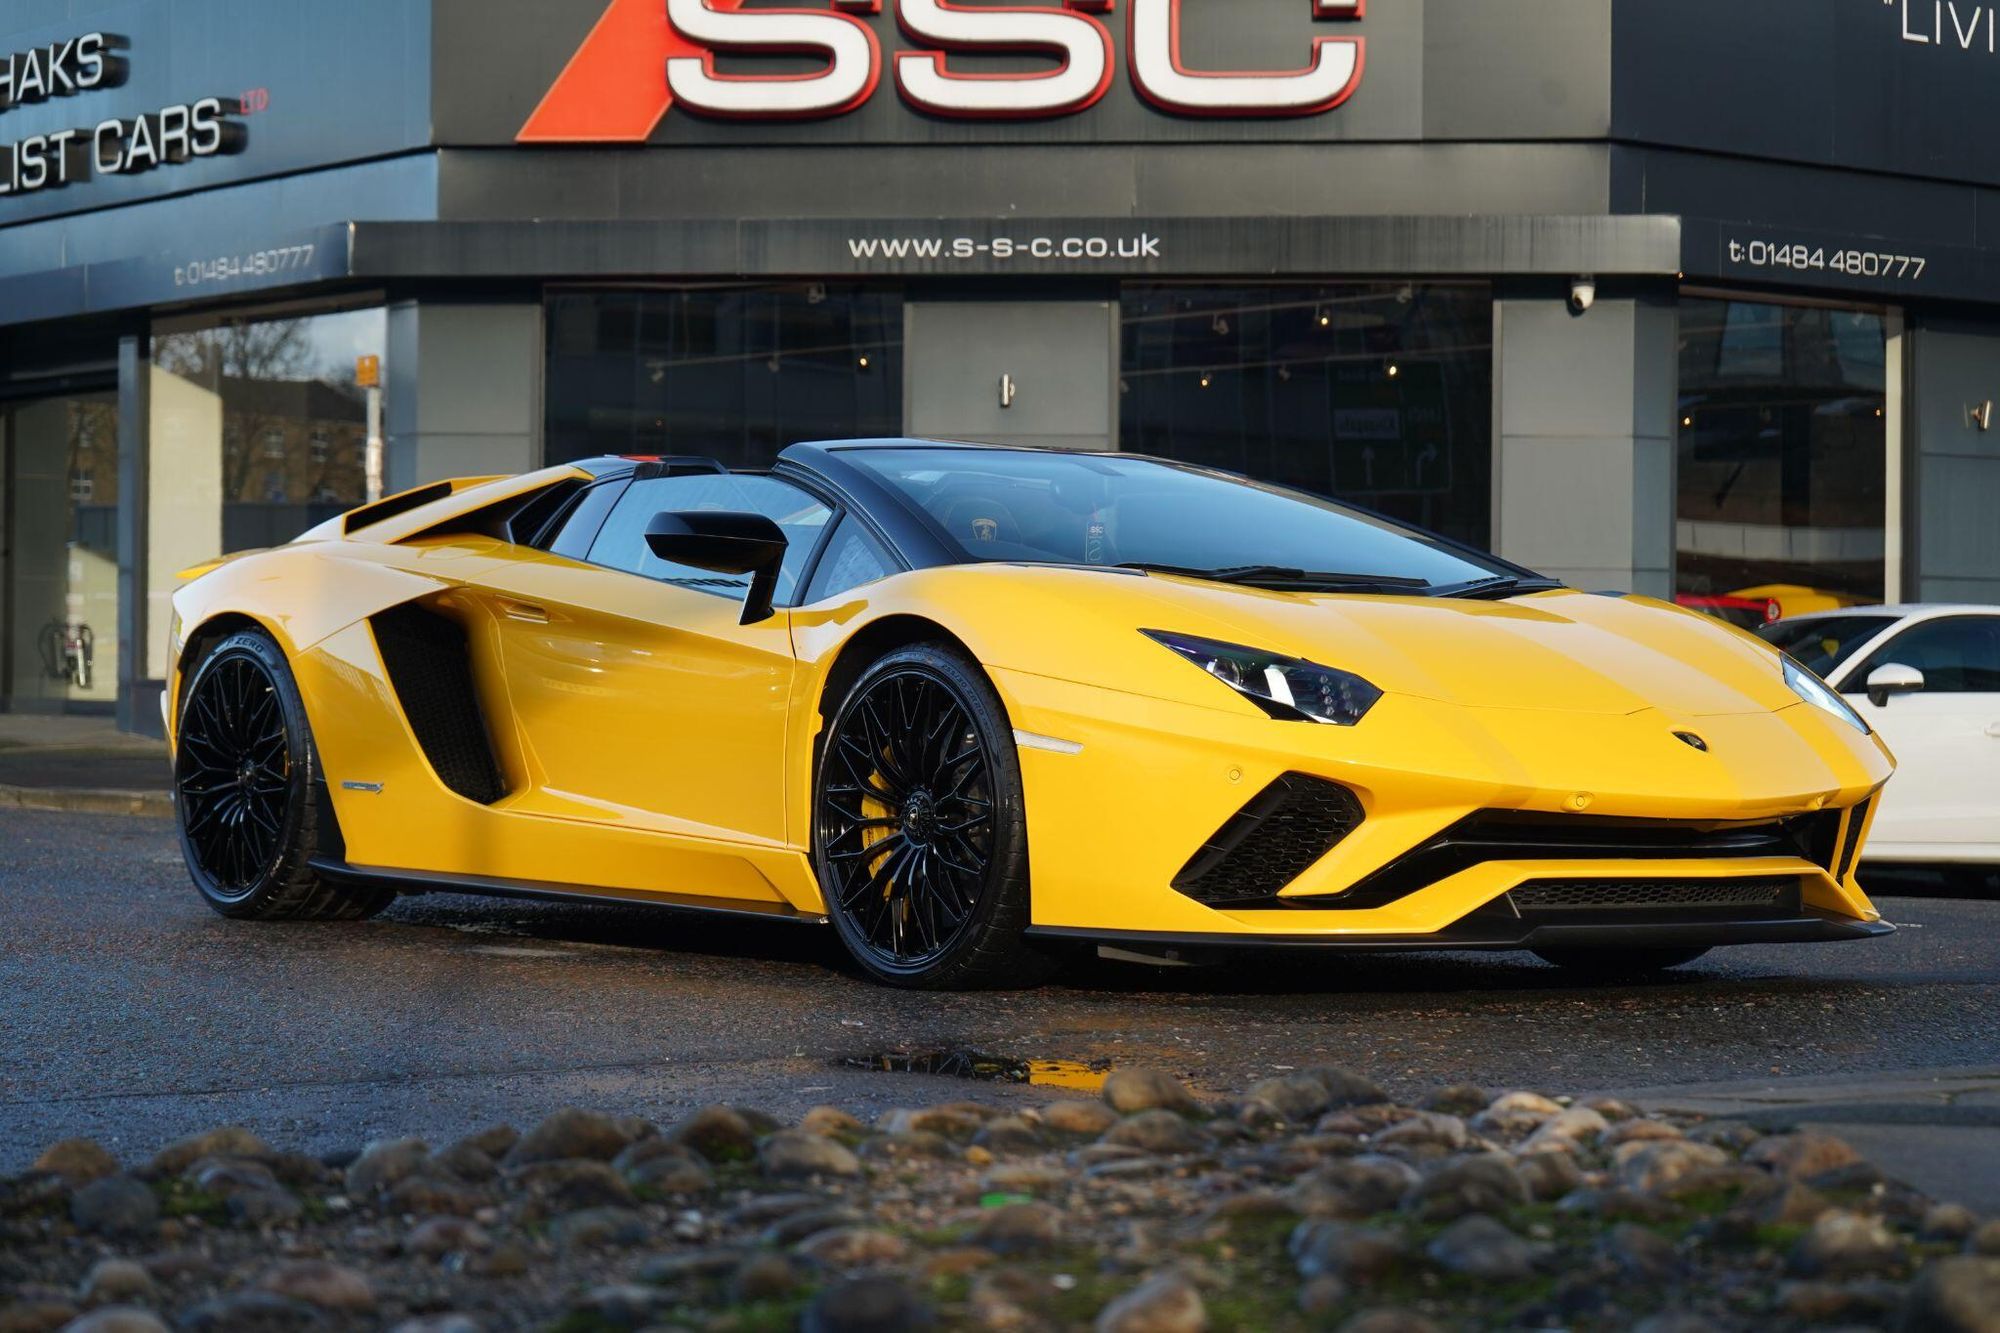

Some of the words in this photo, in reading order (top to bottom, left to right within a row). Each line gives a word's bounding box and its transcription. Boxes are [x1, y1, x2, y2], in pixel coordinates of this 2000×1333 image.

[667, 0, 1365, 118] SSC
[94, 97, 221, 173] CARS
[240, 88, 269, 115] LTD
[848, 232, 1160, 258] www.s-s-c.co.uk
[235, 637, 264, 653] ZERO
